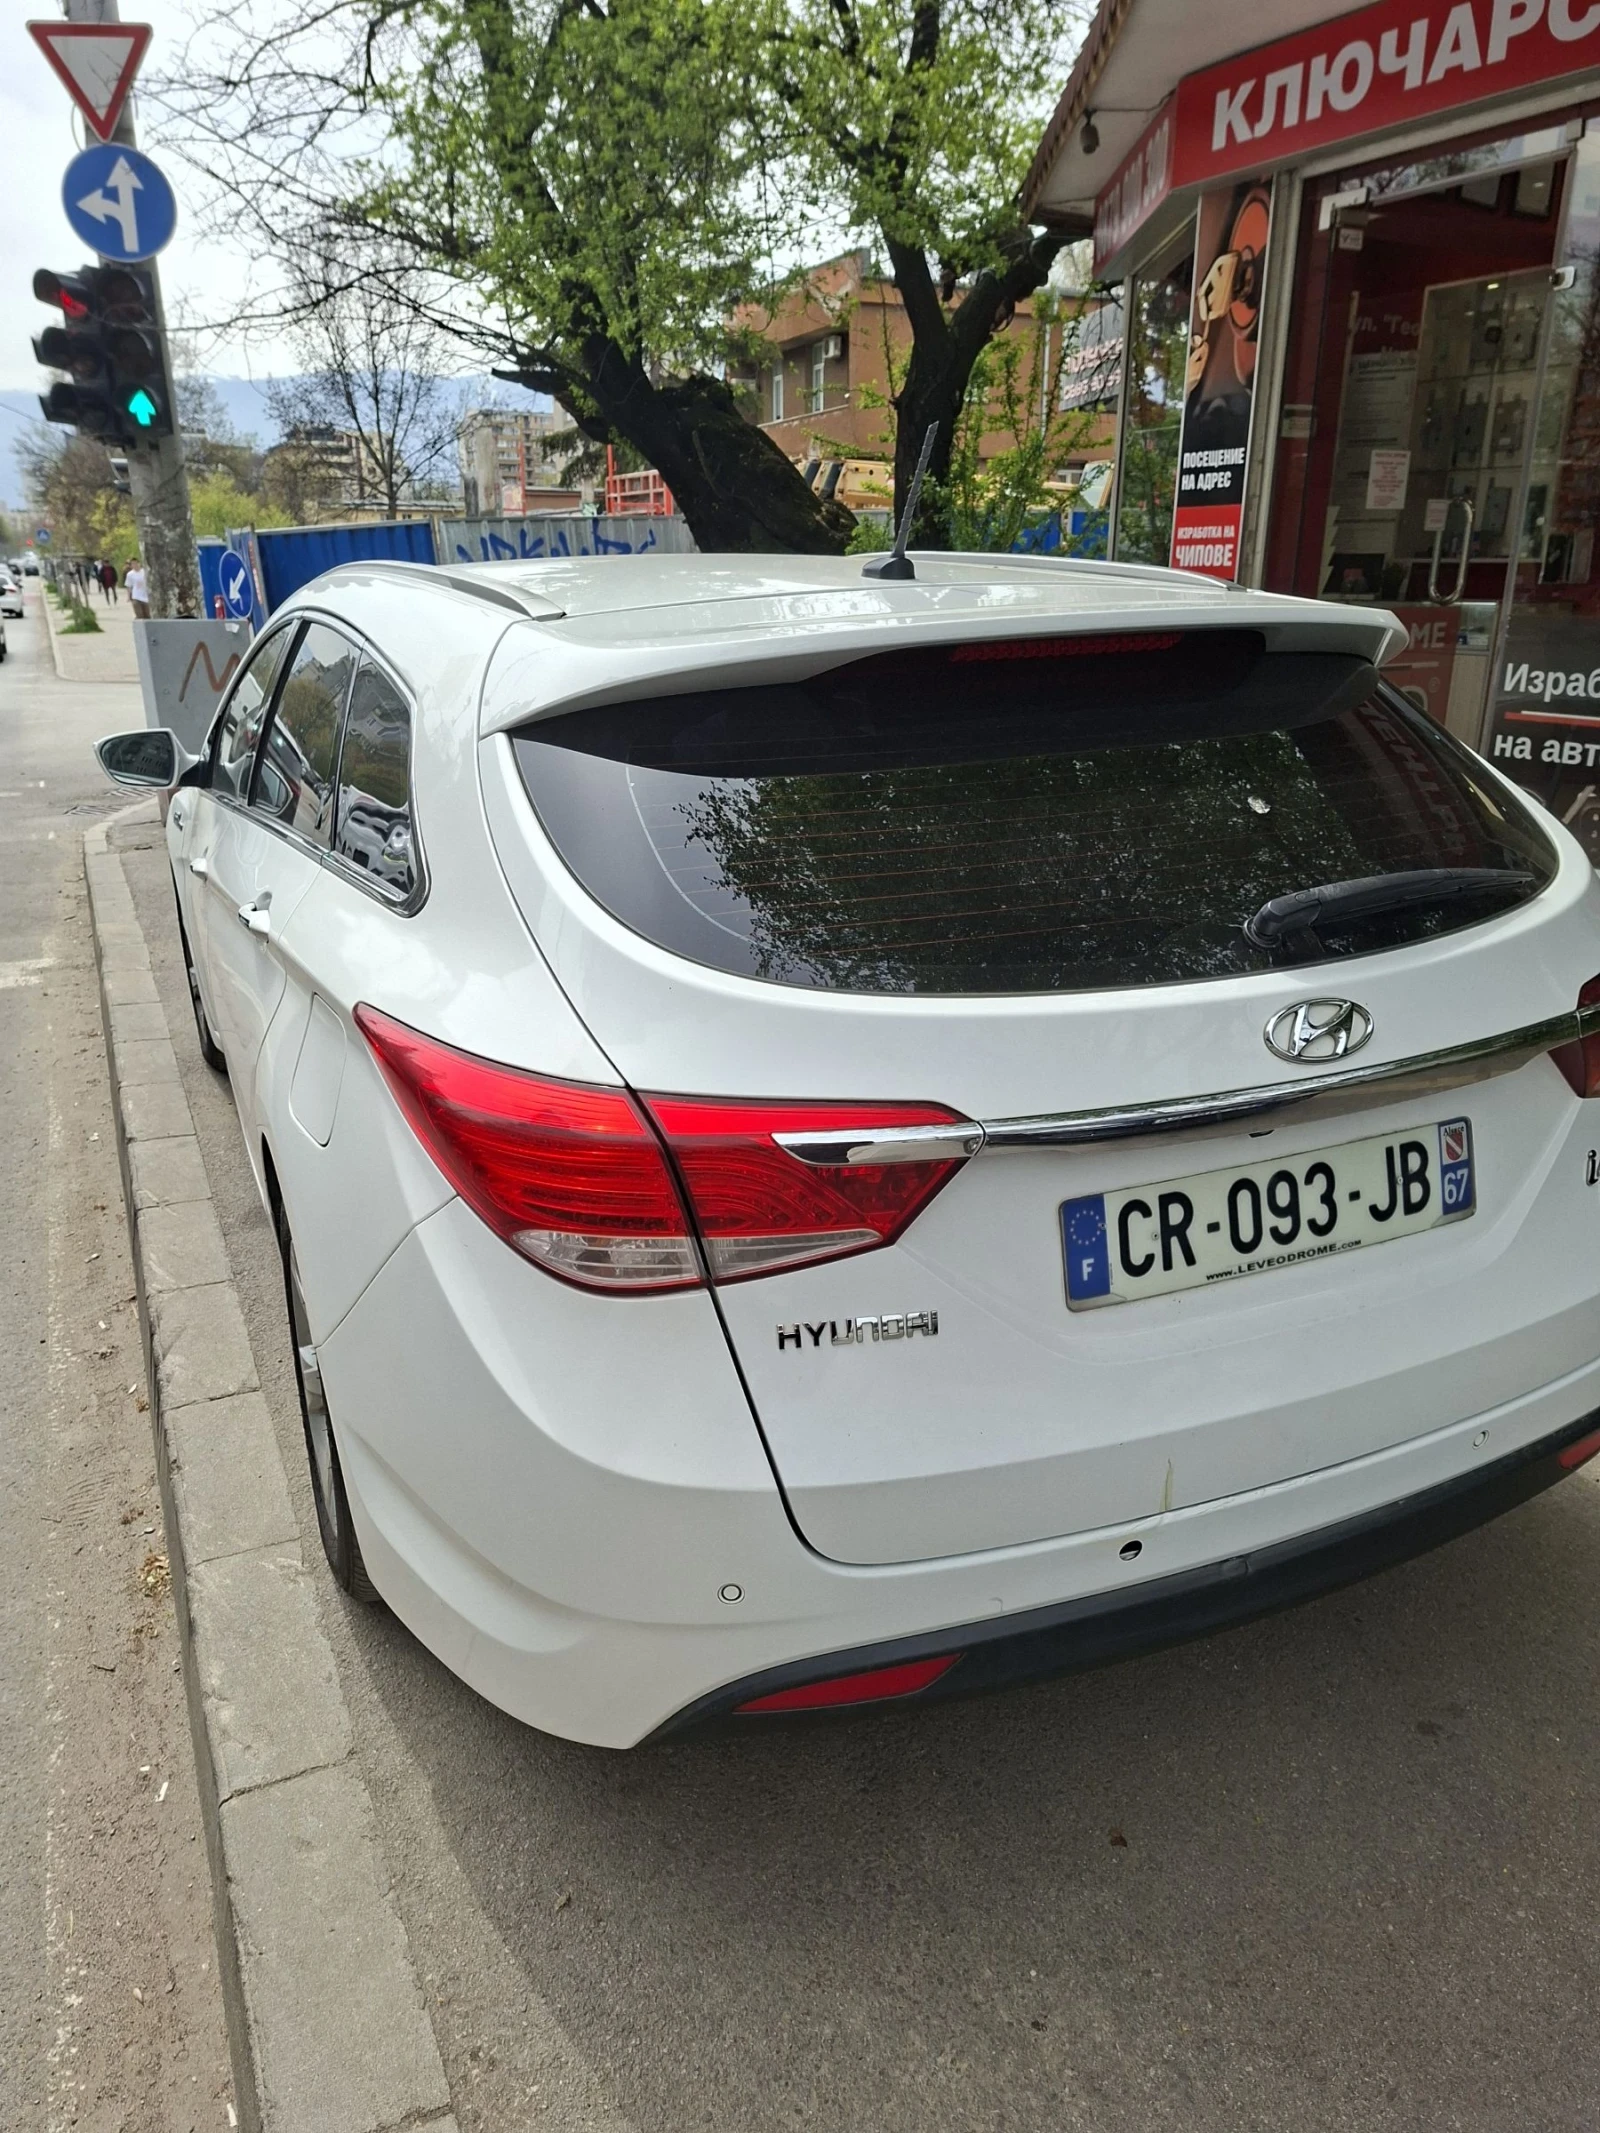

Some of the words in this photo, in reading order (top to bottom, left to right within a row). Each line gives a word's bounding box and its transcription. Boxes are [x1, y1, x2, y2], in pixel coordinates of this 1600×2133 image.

[1183, 447, 1245, 469] ПОСЕЩЕНИЕ
[1181, 473, 1195, 491] НА
[1197, 471, 1232, 491] АДРЕС
[1177, 525, 1222, 539] ИЗРАБОТКА
[1223, 525, 1235, 538] НА
[1175, 544, 1234, 567] ЧИПОВЕ
[1493, 734, 1532, 760] на
[1541, 738, 1600, 767] авт
[1444, 1168, 1468, 1204] 67
[1118, 1140, 1431, 1278] CR-093-JB
[1082, 1258, 1095, 1281] F
[776, 1310, 939, 1350] HYUNDAI
